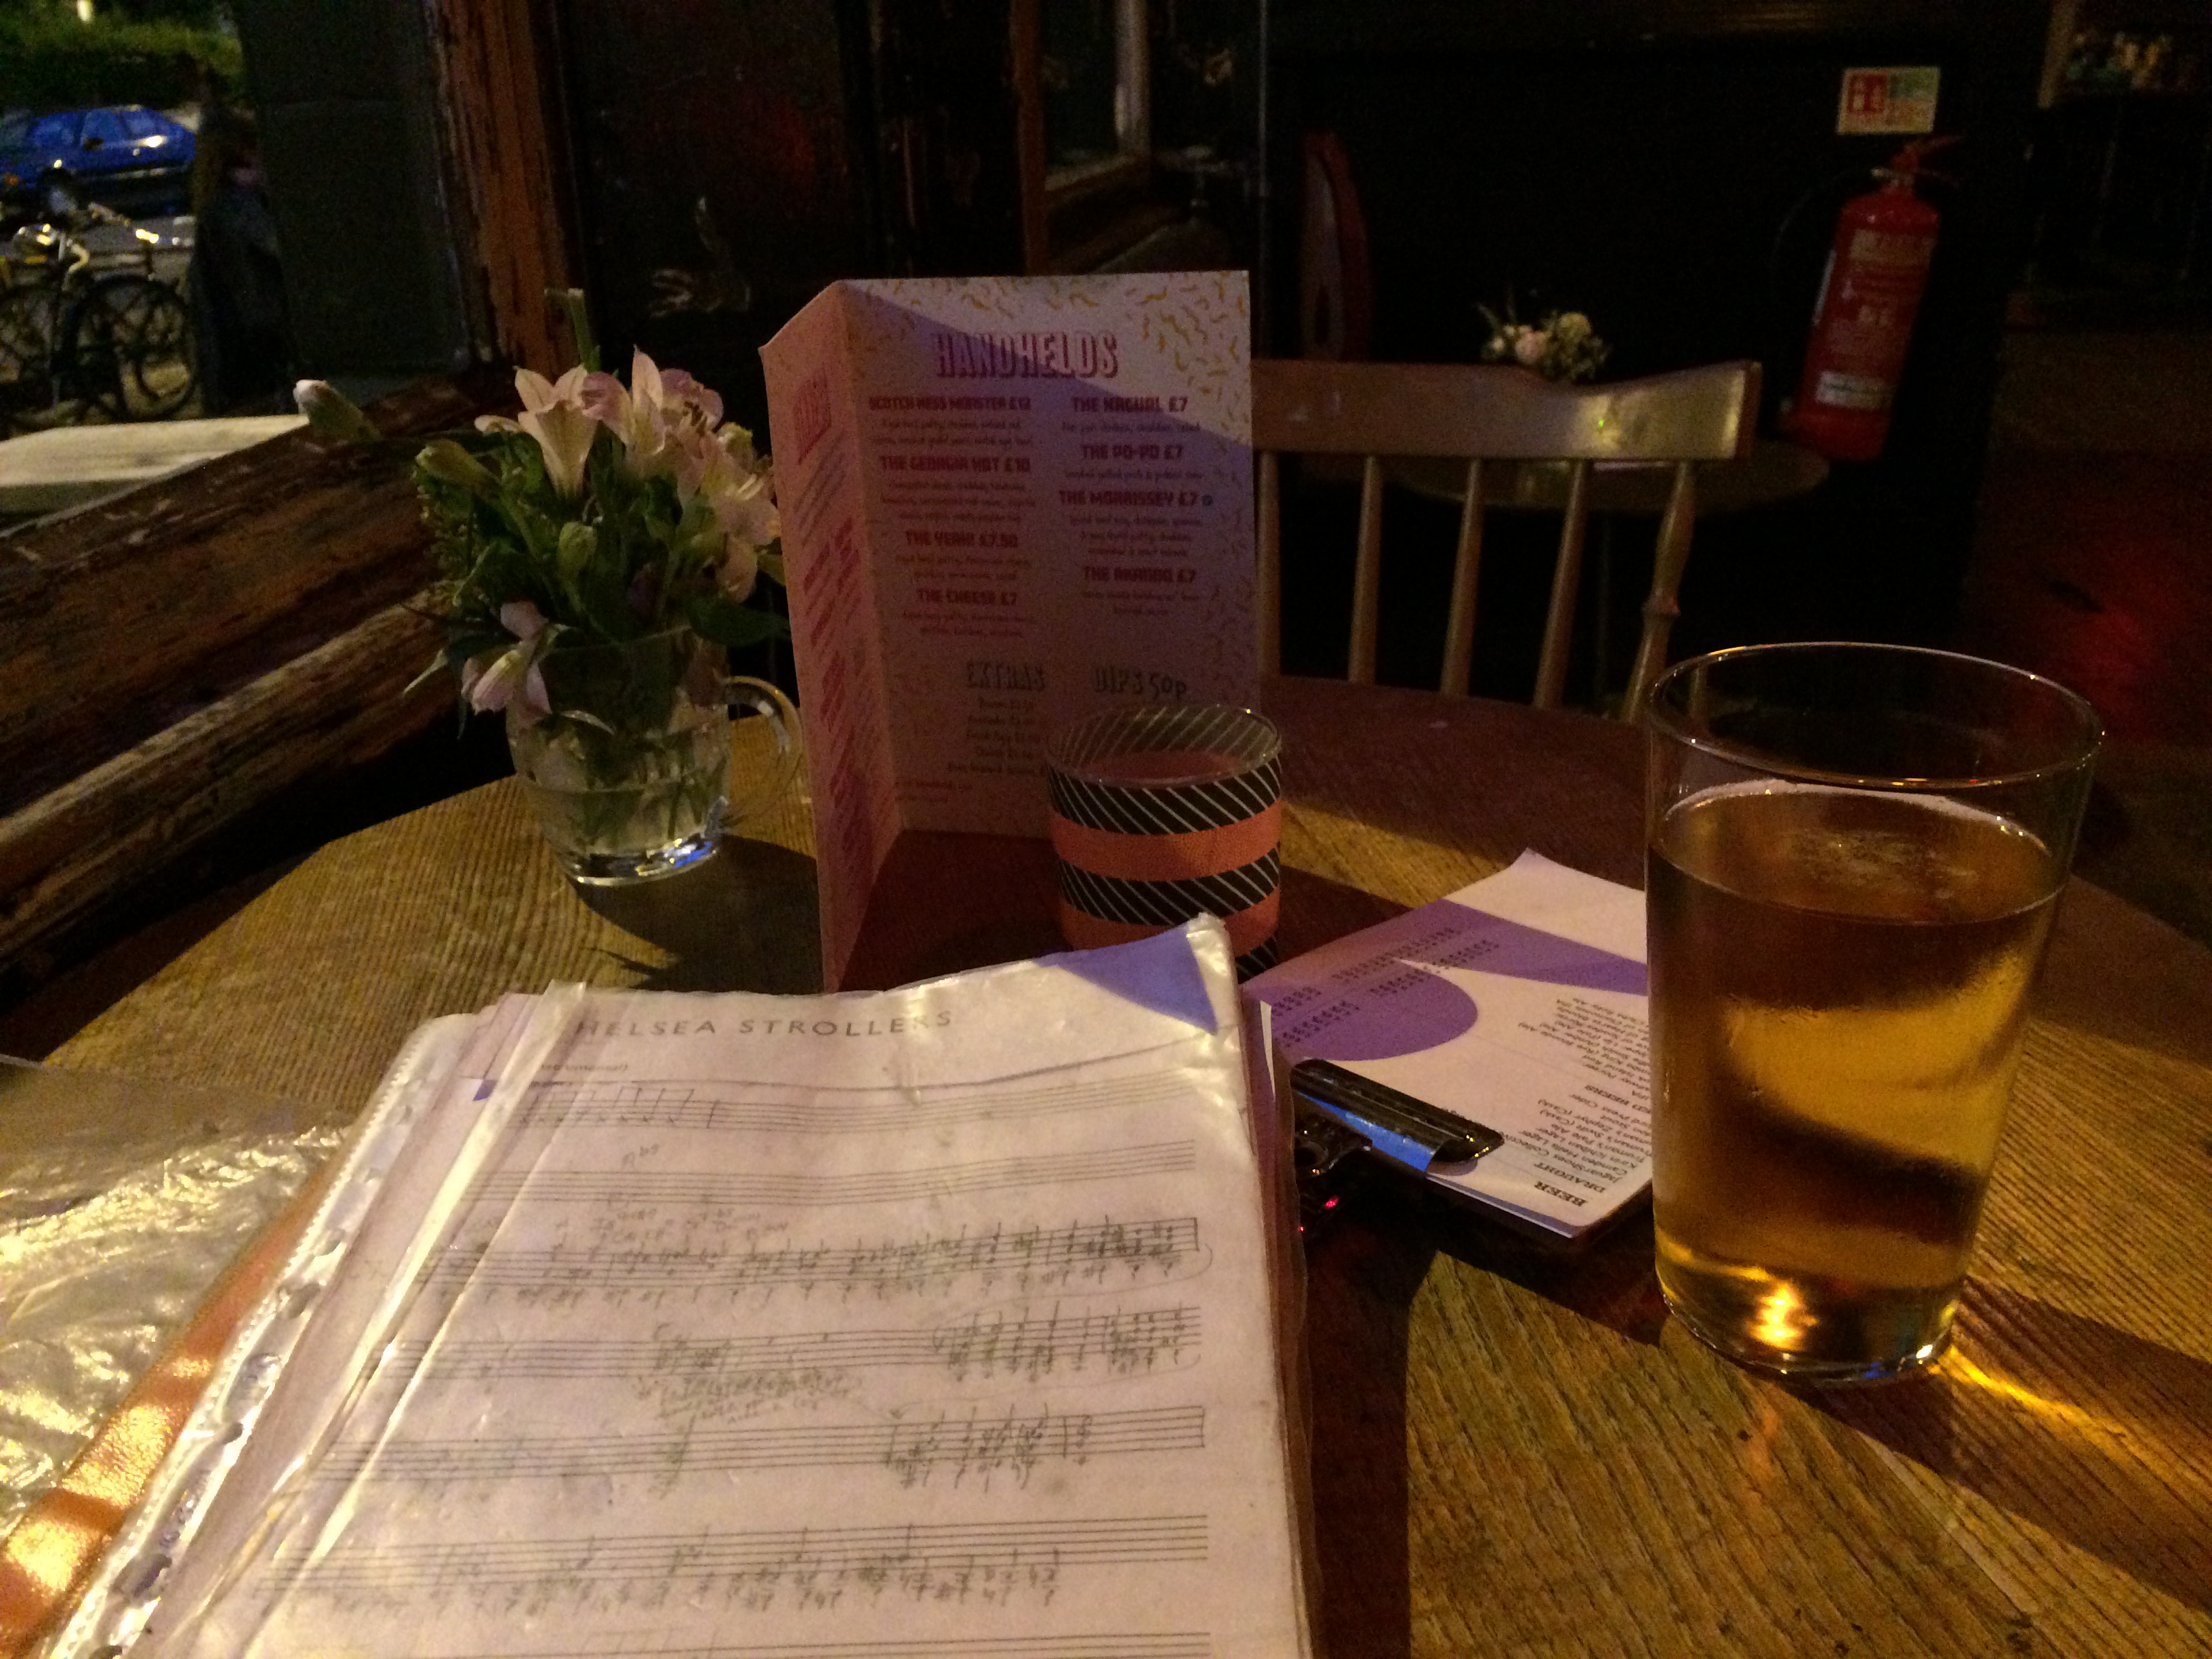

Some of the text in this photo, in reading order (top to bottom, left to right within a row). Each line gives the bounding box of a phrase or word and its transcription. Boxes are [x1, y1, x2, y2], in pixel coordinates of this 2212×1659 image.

[931, 331, 1118, 378] HANDHELDS
[1072, 396, 1099, 412] THE
[1169, 396, 1187, 412] £7
[1082, 445, 1107, 459] THE
[1164, 445, 1183, 459] £7
[880, 455, 907, 470] THE
[1059, 491, 1197, 506] THE MORRISSEY £7
[906, 531, 930, 546] THE
[1084, 566, 1109, 581] THE
[916, 588, 941, 602] THE
[1149, 671, 1187, 700] 50p
[573, 1018, 716, 1037] HELSEA
[1518, 1133, 1549, 1145] Lager
[1536, 1129, 1565, 1142] Lager
[1534, 1161, 1606, 1193] DRAUGHT
[1533, 1180, 1588, 1207] BEER
